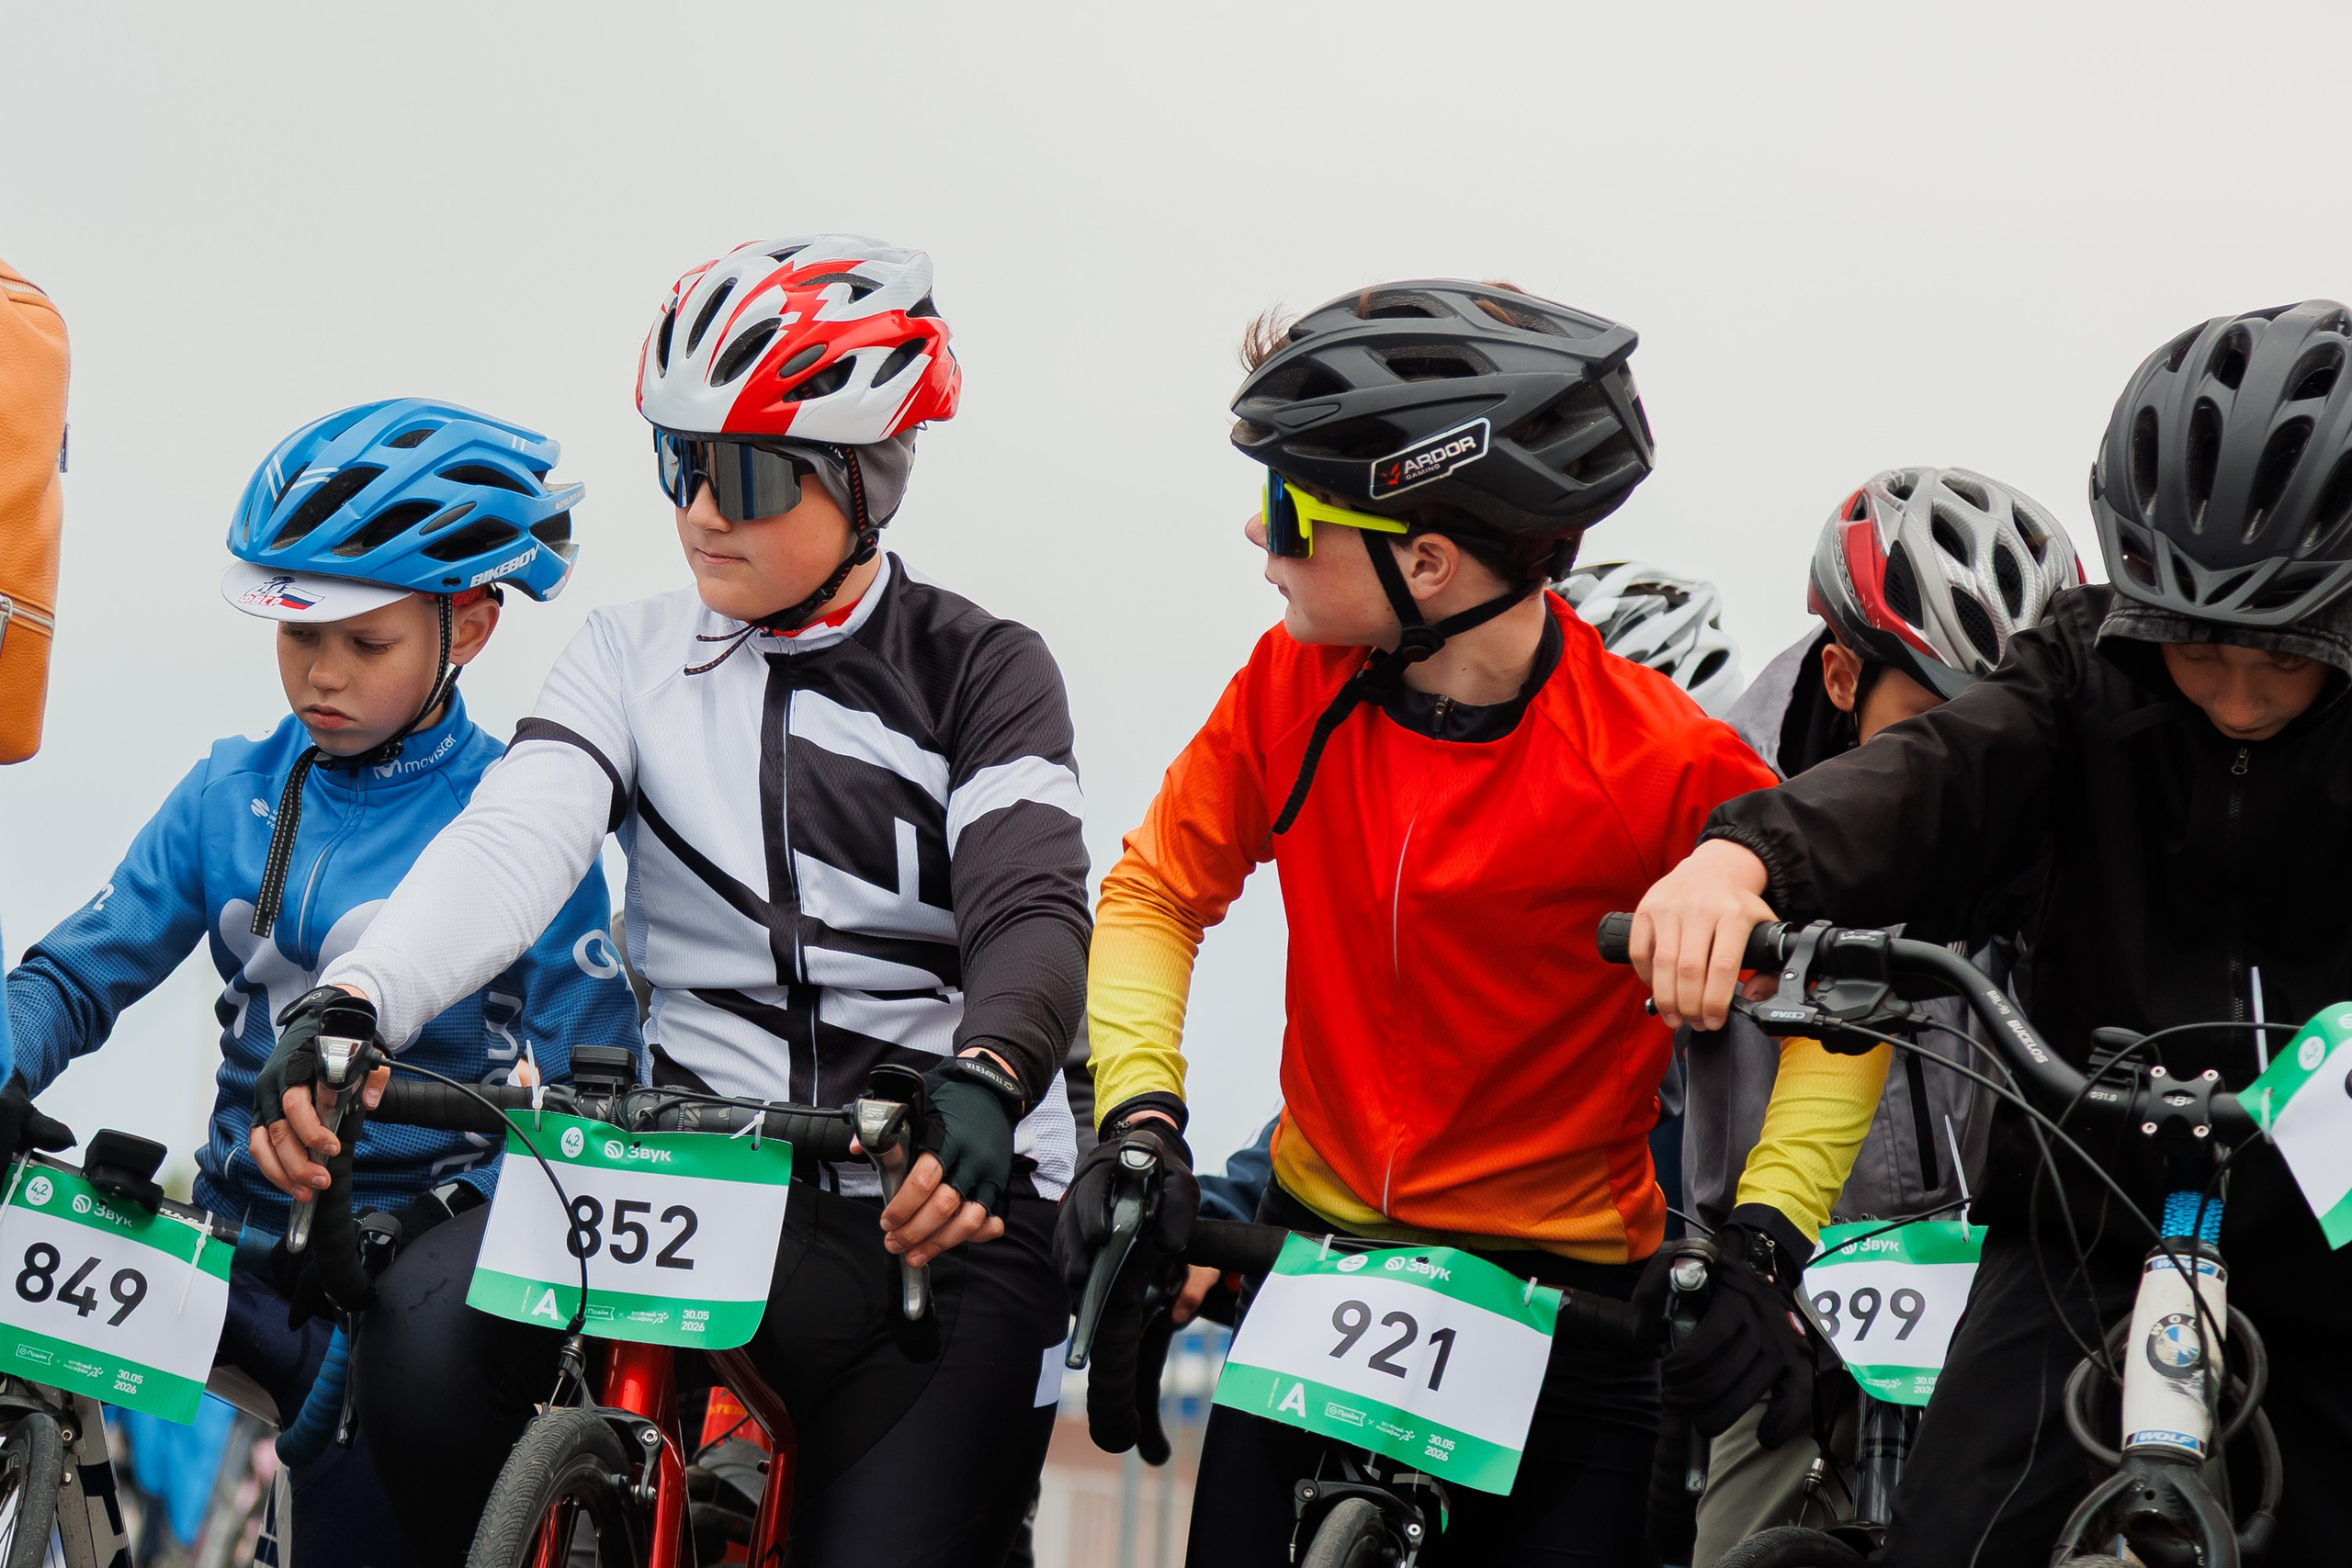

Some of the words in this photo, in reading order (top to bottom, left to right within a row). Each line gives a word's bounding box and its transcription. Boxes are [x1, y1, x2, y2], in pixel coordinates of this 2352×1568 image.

[1404, 436, 1476, 475] ARDOR
[1406, 463, 1441, 479] GAMING
[469, 543, 540, 588] BIKEBOY
[405, 733, 457, 773] movistar
[2007, 1020, 2049, 1064] BUCKLOS
[967, 1062, 1009, 1087] TEMPESTA
[565, 1134, 581, 1147] 4,2
[627, 1145, 672, 1163] Звук
[30, 1180, 49, 1196] 4,2
[93, 1202, 132, 1228] Звук
[566, 1194, 699, 1270] 852
[1860, 1237, 1900, 1253] Звук
[1407, 1258, 1452, 1281] Звук
[15, 1241, 149, 1327] 849
[683, 1309, 710, 1320] 30.05
[1810, 1287, 1926, 1342] 899
[681, 1321, 706, 1333] 2026
[1329, 1300, 1457, 1392] 921
[117, 1369, 143, 1385] 30.05
[113, 1380, 137, 1395] 2026
[1428, 1434, 1455, 1450] 30.05
[2139, 1433, 2195, 1443] WOLF
[1424, 1445, 1449, 1461] 2026
